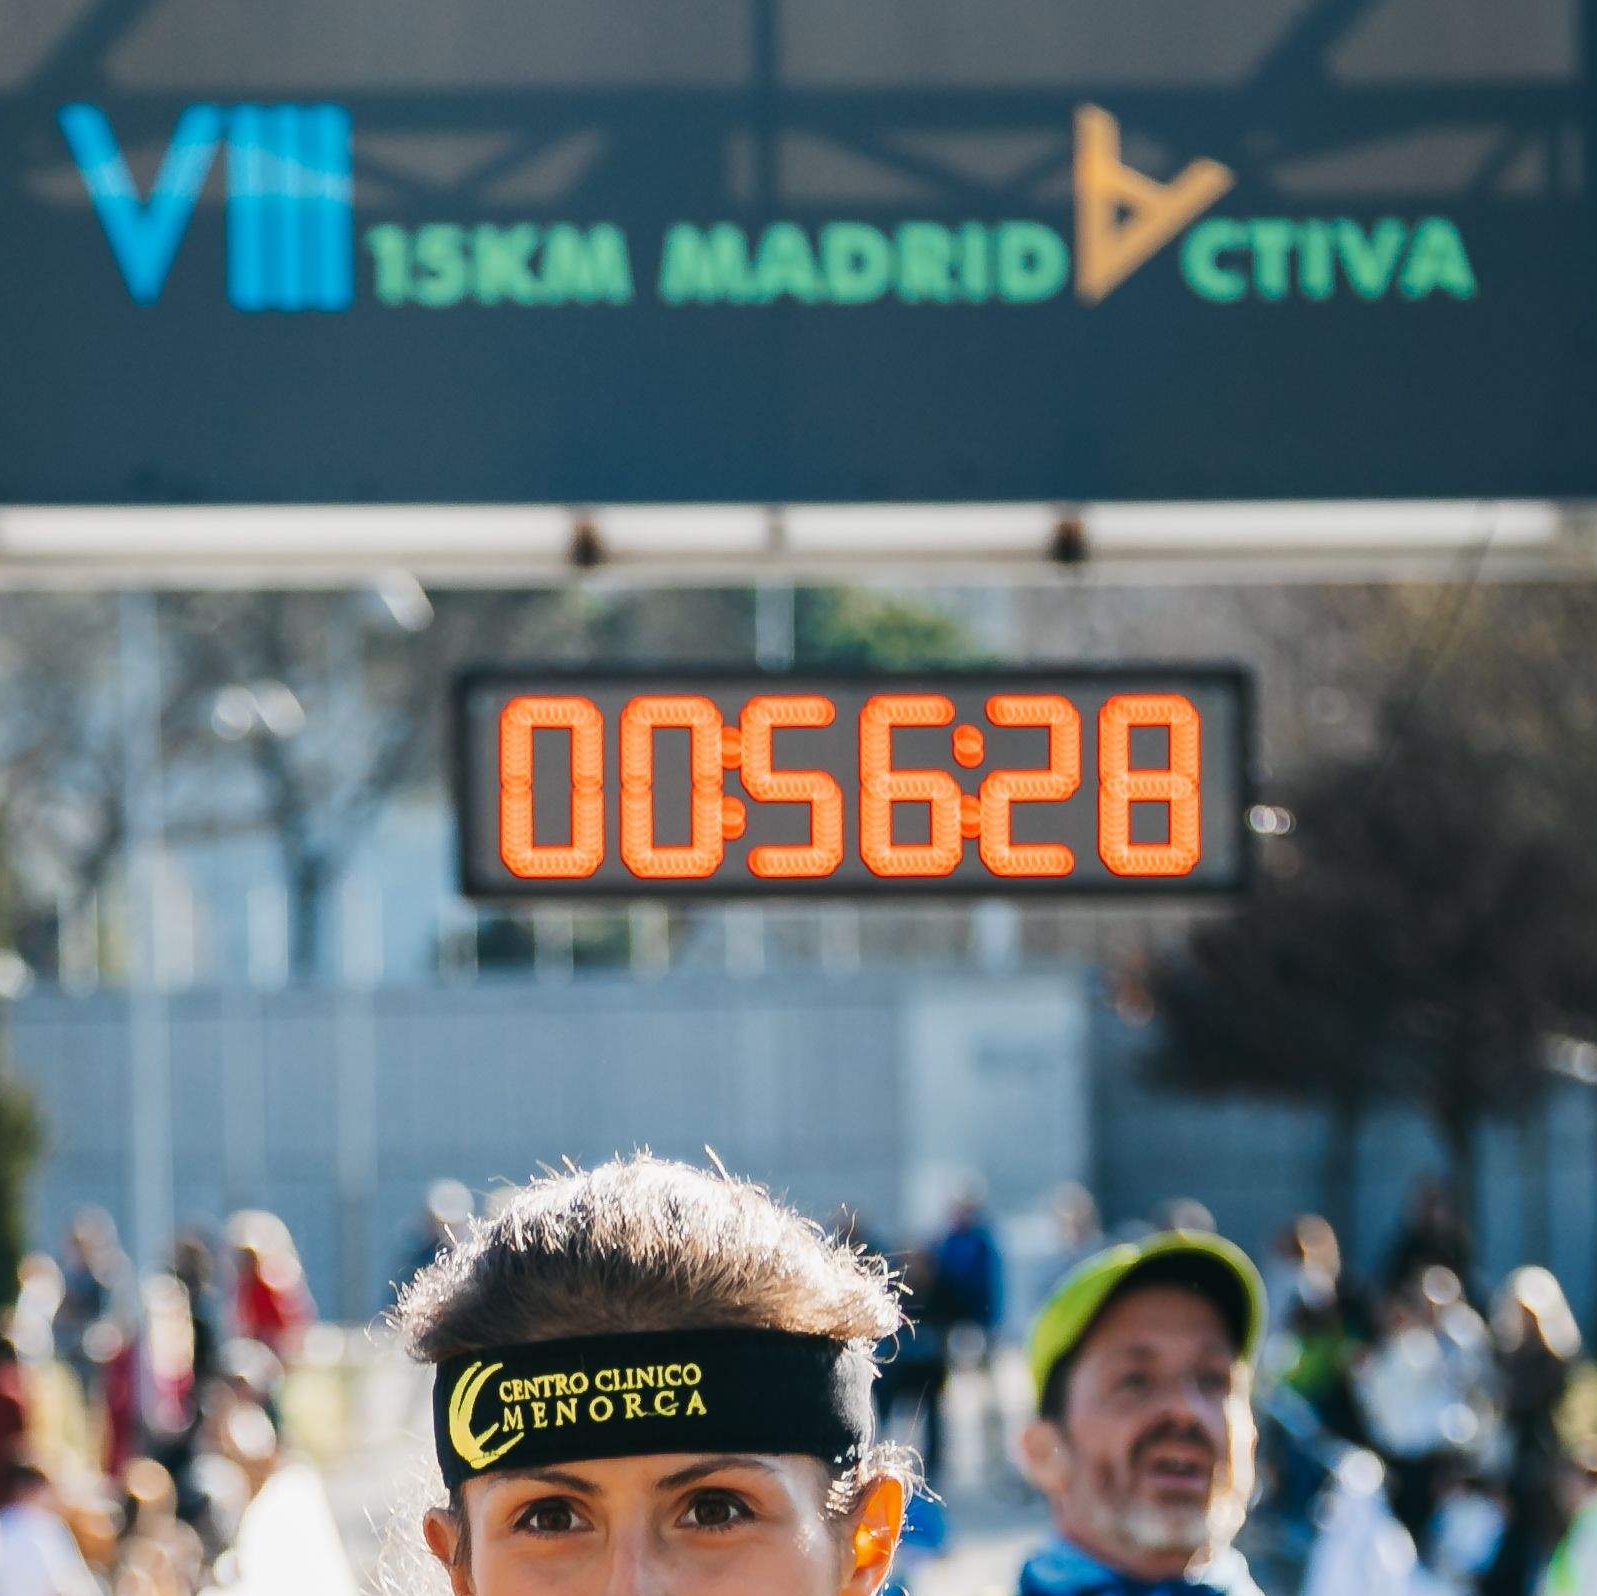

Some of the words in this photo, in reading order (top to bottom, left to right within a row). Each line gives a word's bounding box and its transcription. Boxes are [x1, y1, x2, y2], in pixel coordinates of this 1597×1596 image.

[56, 102, 354, 311] VIII
[366, 219, 633, 308] 15KM
[658, 219, 1069, 307] MADRID
[499, 693, 1201, 878] 00:56:28
[499, 1372, 588, 1403] CENTRO
[595, 1363, 702, 1394] CLINICO
[502, 1393, 707, 1432] MENORCA
